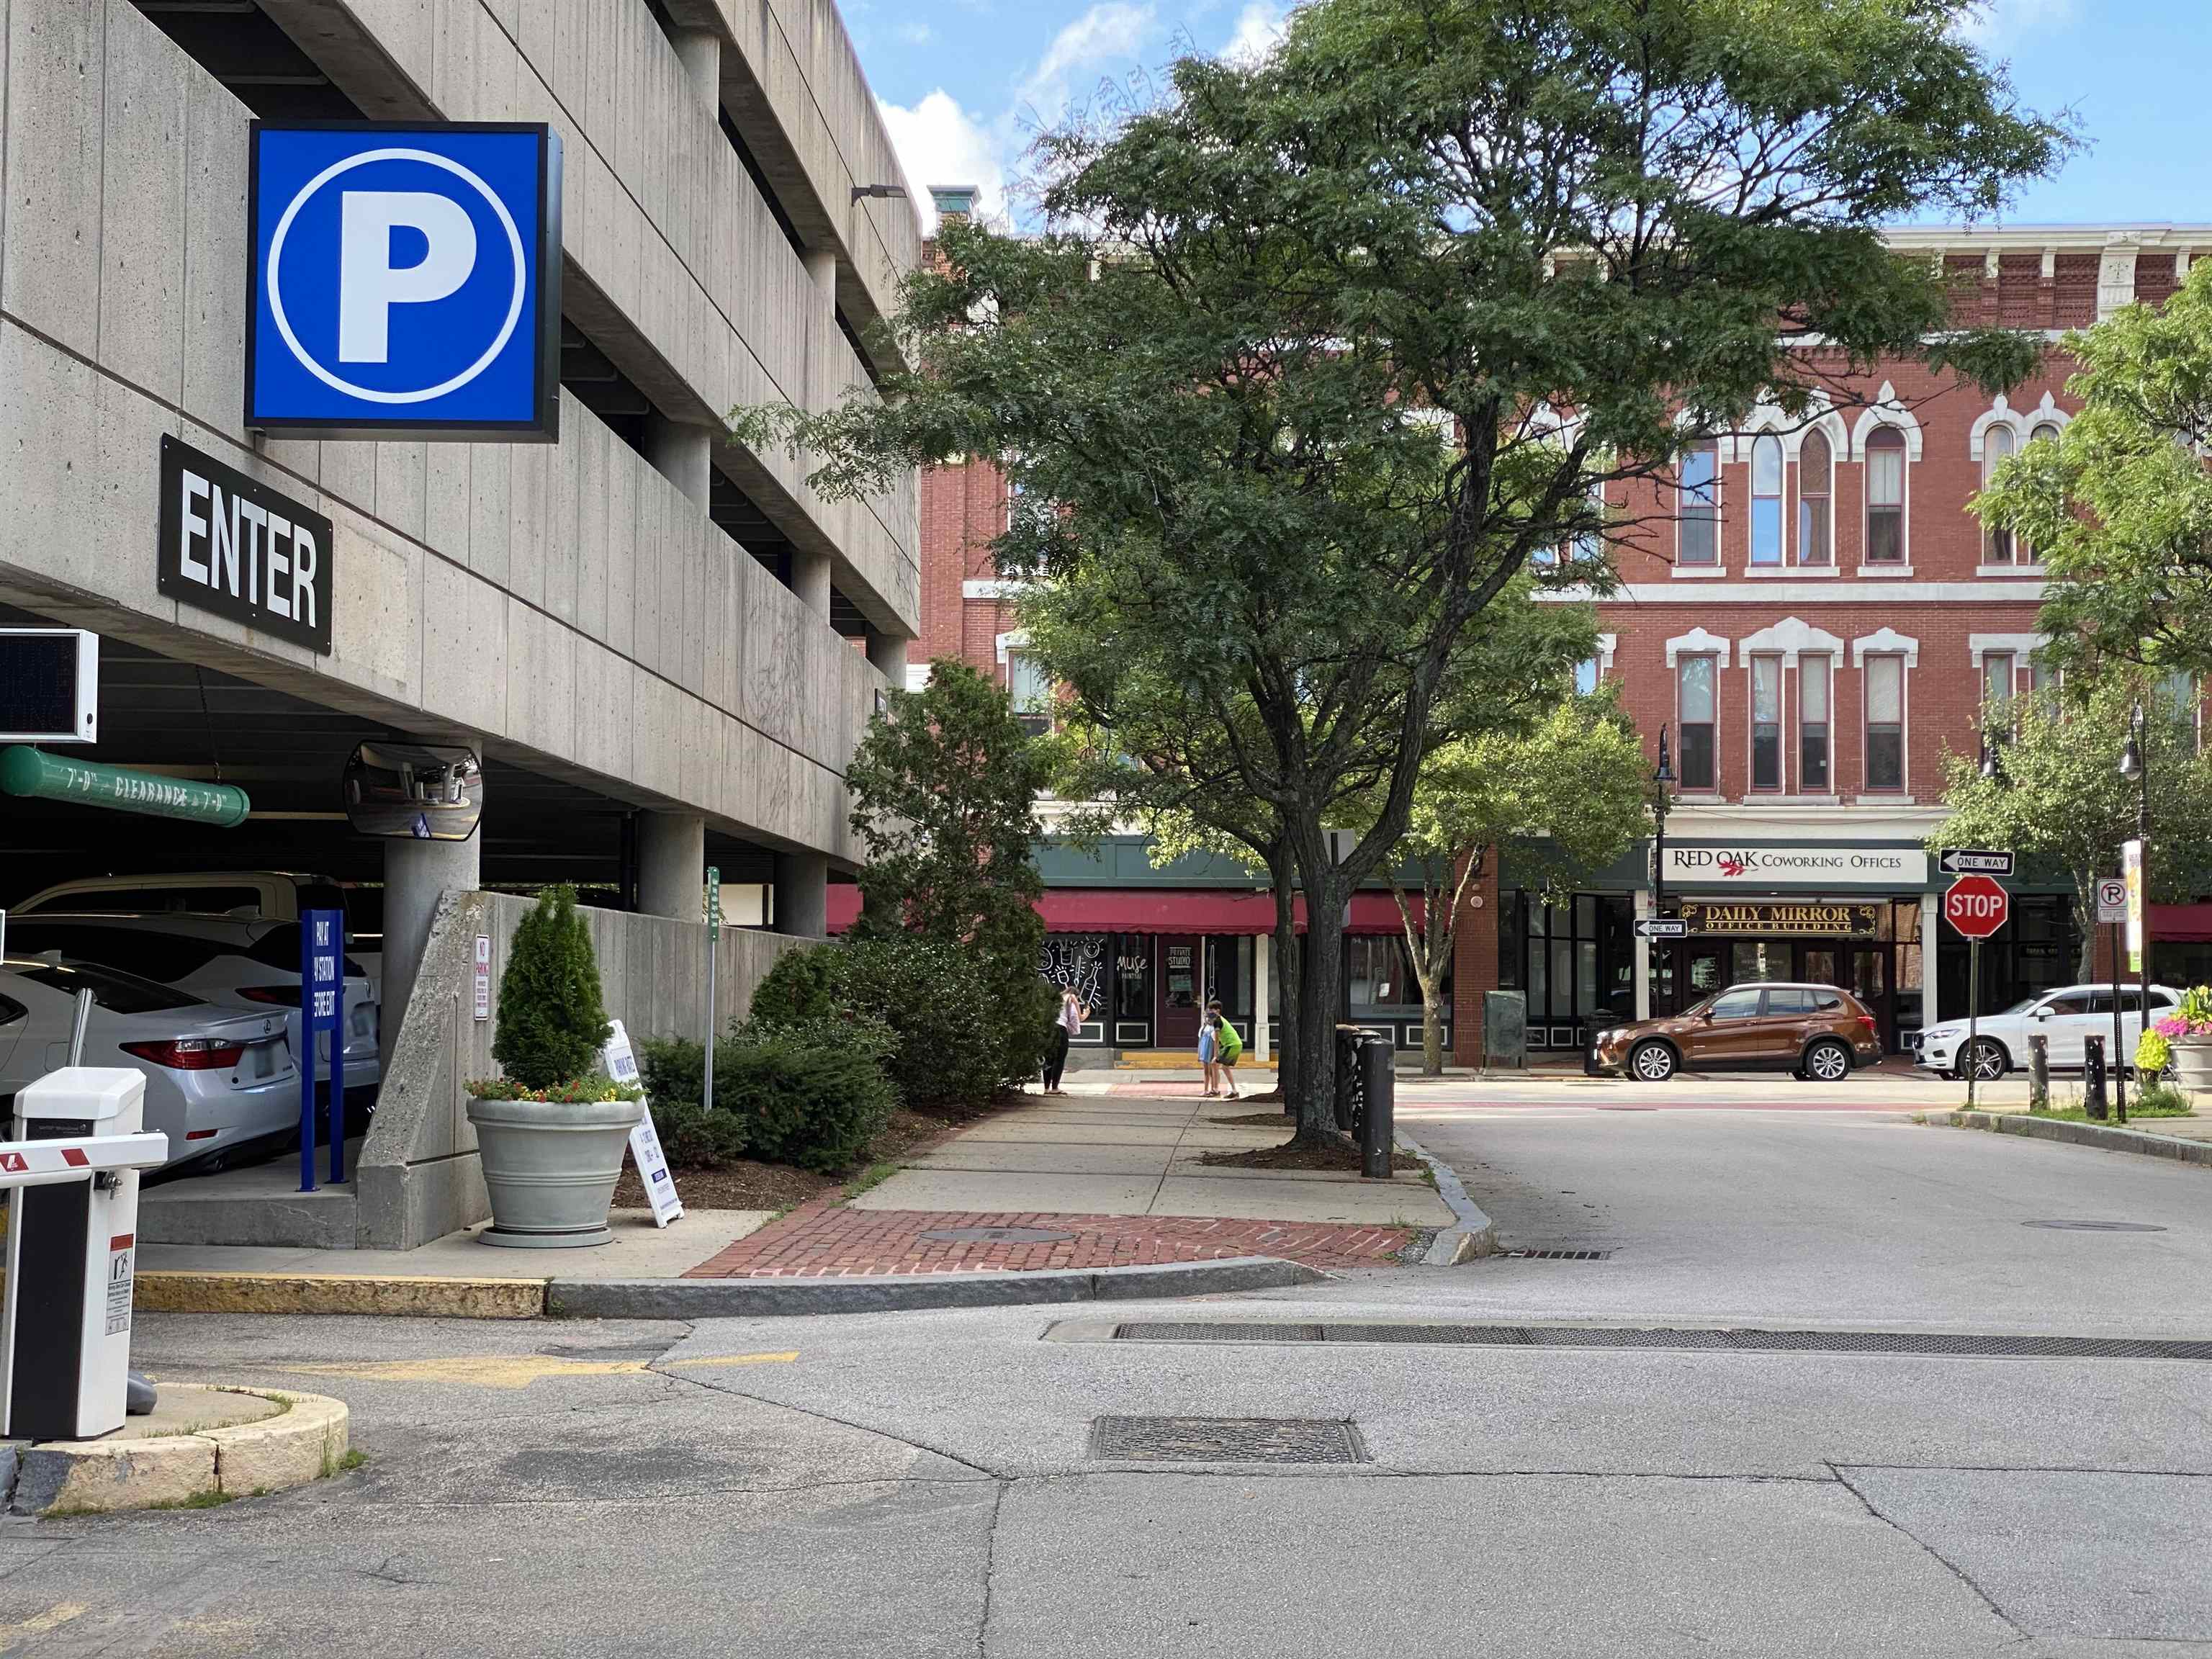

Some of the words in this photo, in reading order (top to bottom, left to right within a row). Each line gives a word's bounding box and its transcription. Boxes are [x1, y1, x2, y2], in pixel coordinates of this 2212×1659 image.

[339, 190, 477, 364] P
[180, 468, 317, 628] ENTER
[114, 776, 188, 807] CLEARANCE
[1673, 850, 1713, 868] RED
[1717, 850, 1760, 867] OAK
[1761, 854, 1844, 868] COWORKING
[1851, 855, 1902, 868] OFFICES
[1957, 857, 1979, 867] ONE
[1984, 858, 2007, 868] WAY
[1705, 907, 1763, 920] DAILY
[1771, 907, 1851, 922] MIRROR
[1950, 894, 2003, 918] STOP
[324, 921, 330, 946] AT
[1665, 925, 1680, 933] WAY
[319, 956, 335, 981] STATION
[1168, 956, 1191, 966] STUDIO
[326, 990, 336, 1016] EXIT
